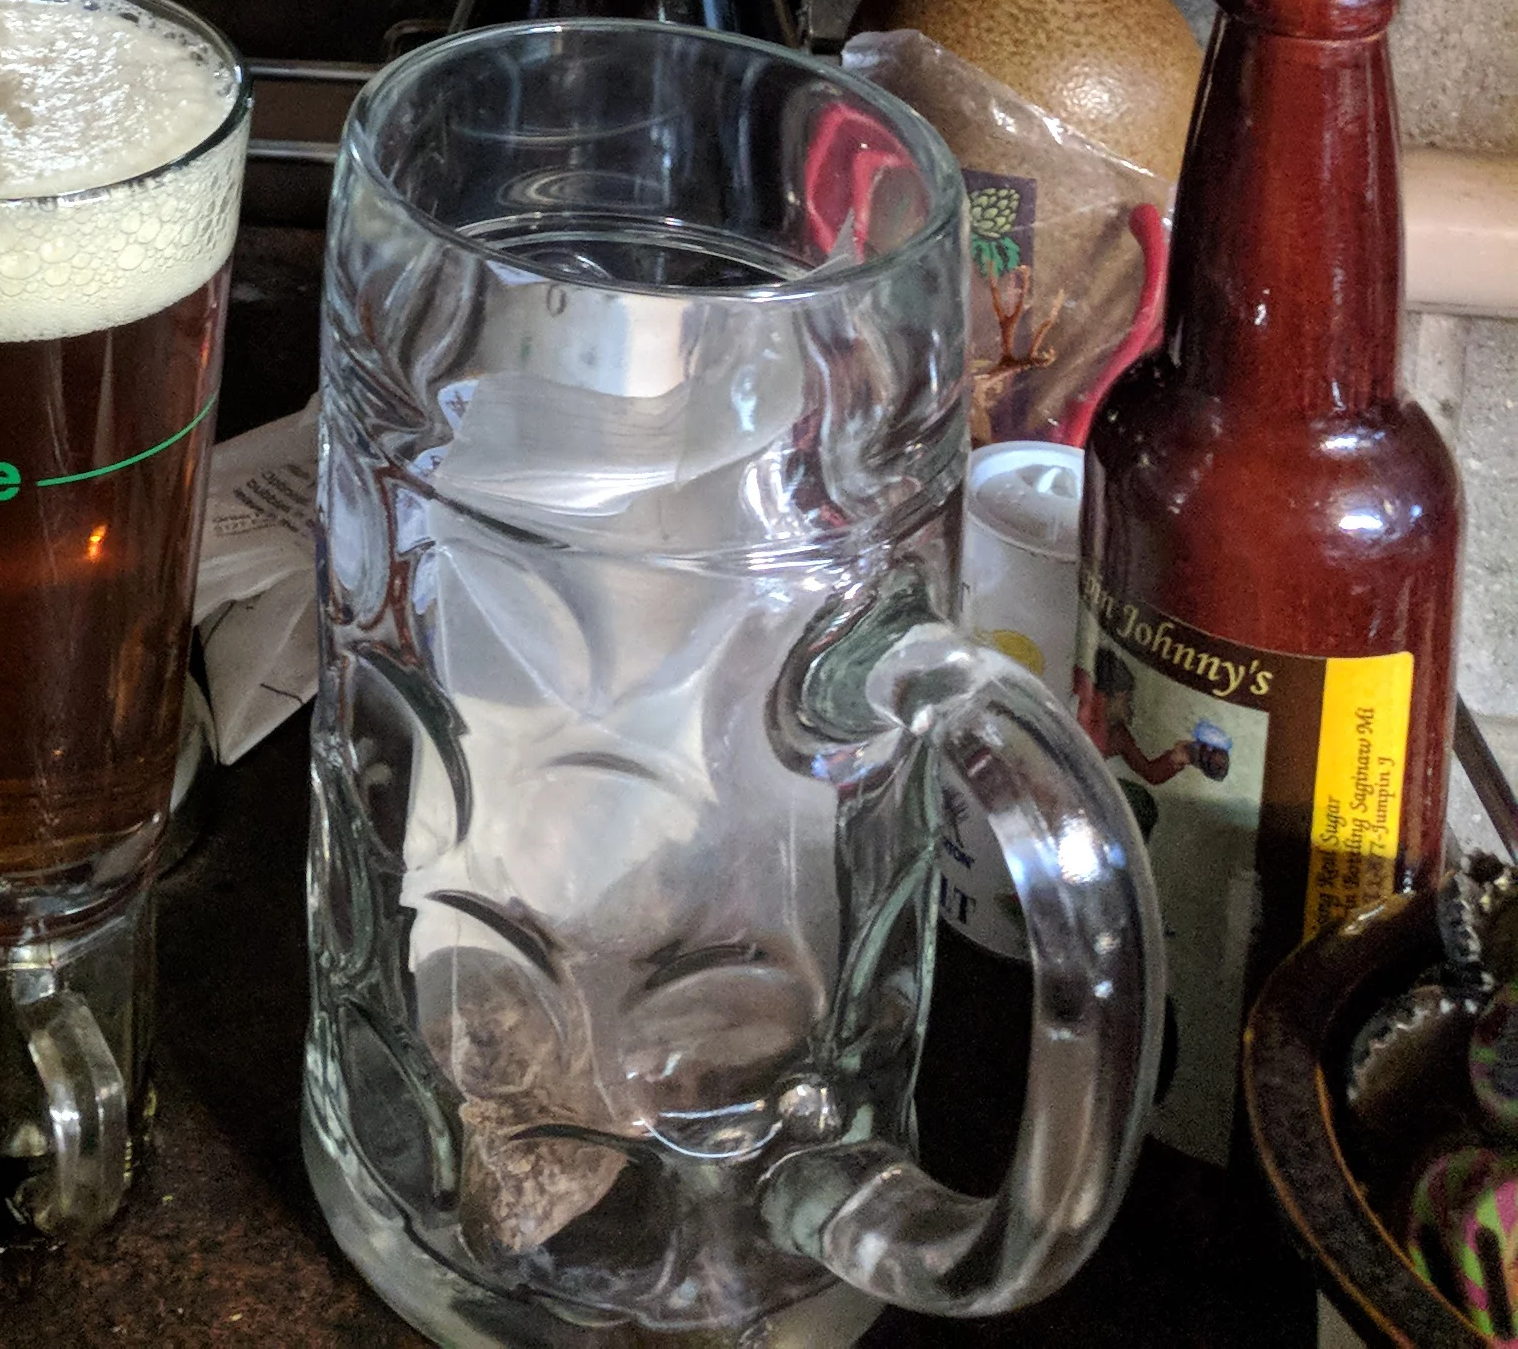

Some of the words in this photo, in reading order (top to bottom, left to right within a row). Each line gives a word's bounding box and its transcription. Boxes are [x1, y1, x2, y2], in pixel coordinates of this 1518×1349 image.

[1116, 603, 1275, 698] Johnny's
[1349, 738, 1374, 813] Saginaw
[1320, 795, 1347, 846] Sugar
